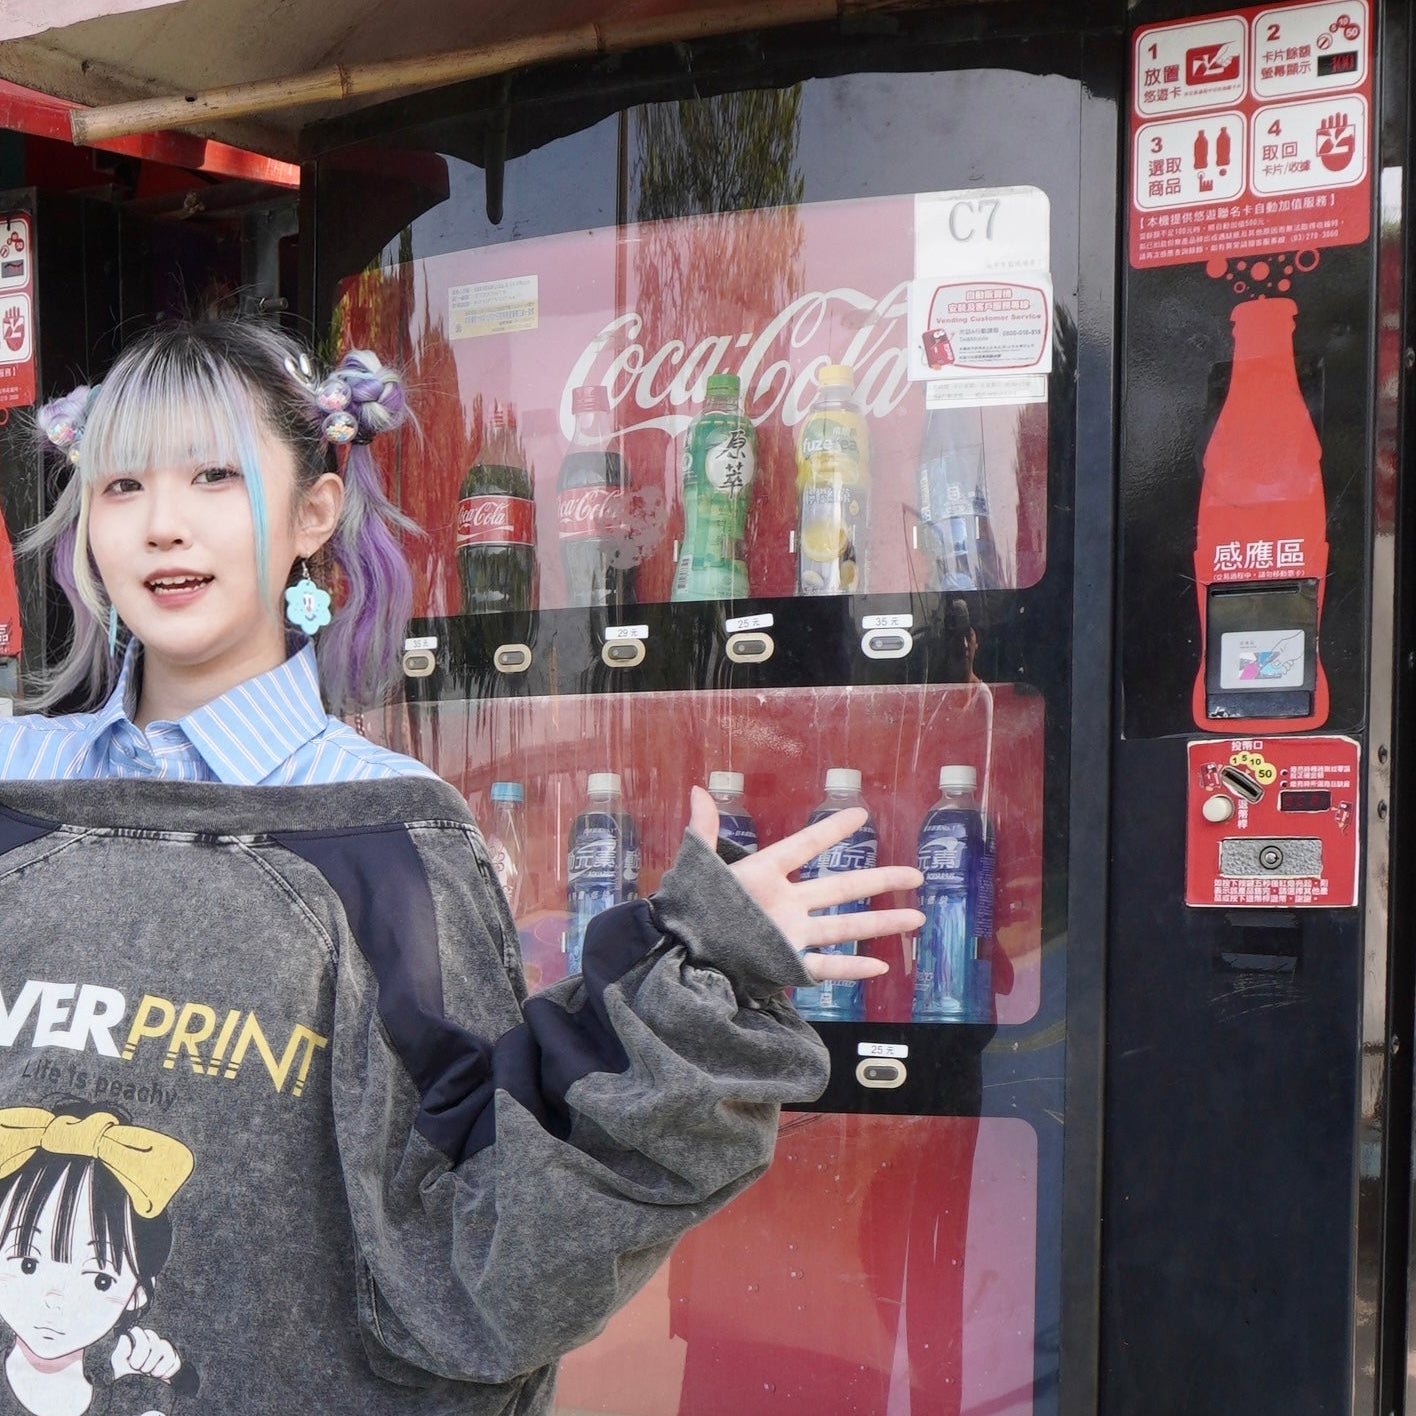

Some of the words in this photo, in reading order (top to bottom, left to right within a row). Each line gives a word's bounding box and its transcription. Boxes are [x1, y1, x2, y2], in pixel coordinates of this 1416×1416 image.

[1266, 24, 1280, 41] 2
[1148, 43, 1157, 60] 1
[1144, 64, 1180, 87] 放置
[1144, 86, 1182, 103] 悠遊卡
[1267, 119, 1282, 137] 4
[1151, 137, 1163, 153] 3
[1262, 141, 1298, 160] 取回
[1148, 157, 1182, 176] 選取
[1148, 178, 1182, 197] 商品
[949, 199, 1000, 242] C7
[970, 314, 1009, 322] Customer
[1011, 312, 1042, 321] Service
[559, 281, 914, 444] Coca-Cola
[715, 429, 747, 499] 原萃
[1214, 538, 1305, 572] 感應區
[737, 619, 749, 629] 25
[875, 617, 887, 626] 35
[1250, 758, 1261, 766] 10
[1258, 769, 1272, 779] 50
[122, 994, 328, 1098] PRINT
[871, 1045, 883, 1055] 25
[22, 1059, 61, 1084] Life
[67, 1065, 87, 1090] is
[93, 1073, 178, 1113] peachy
